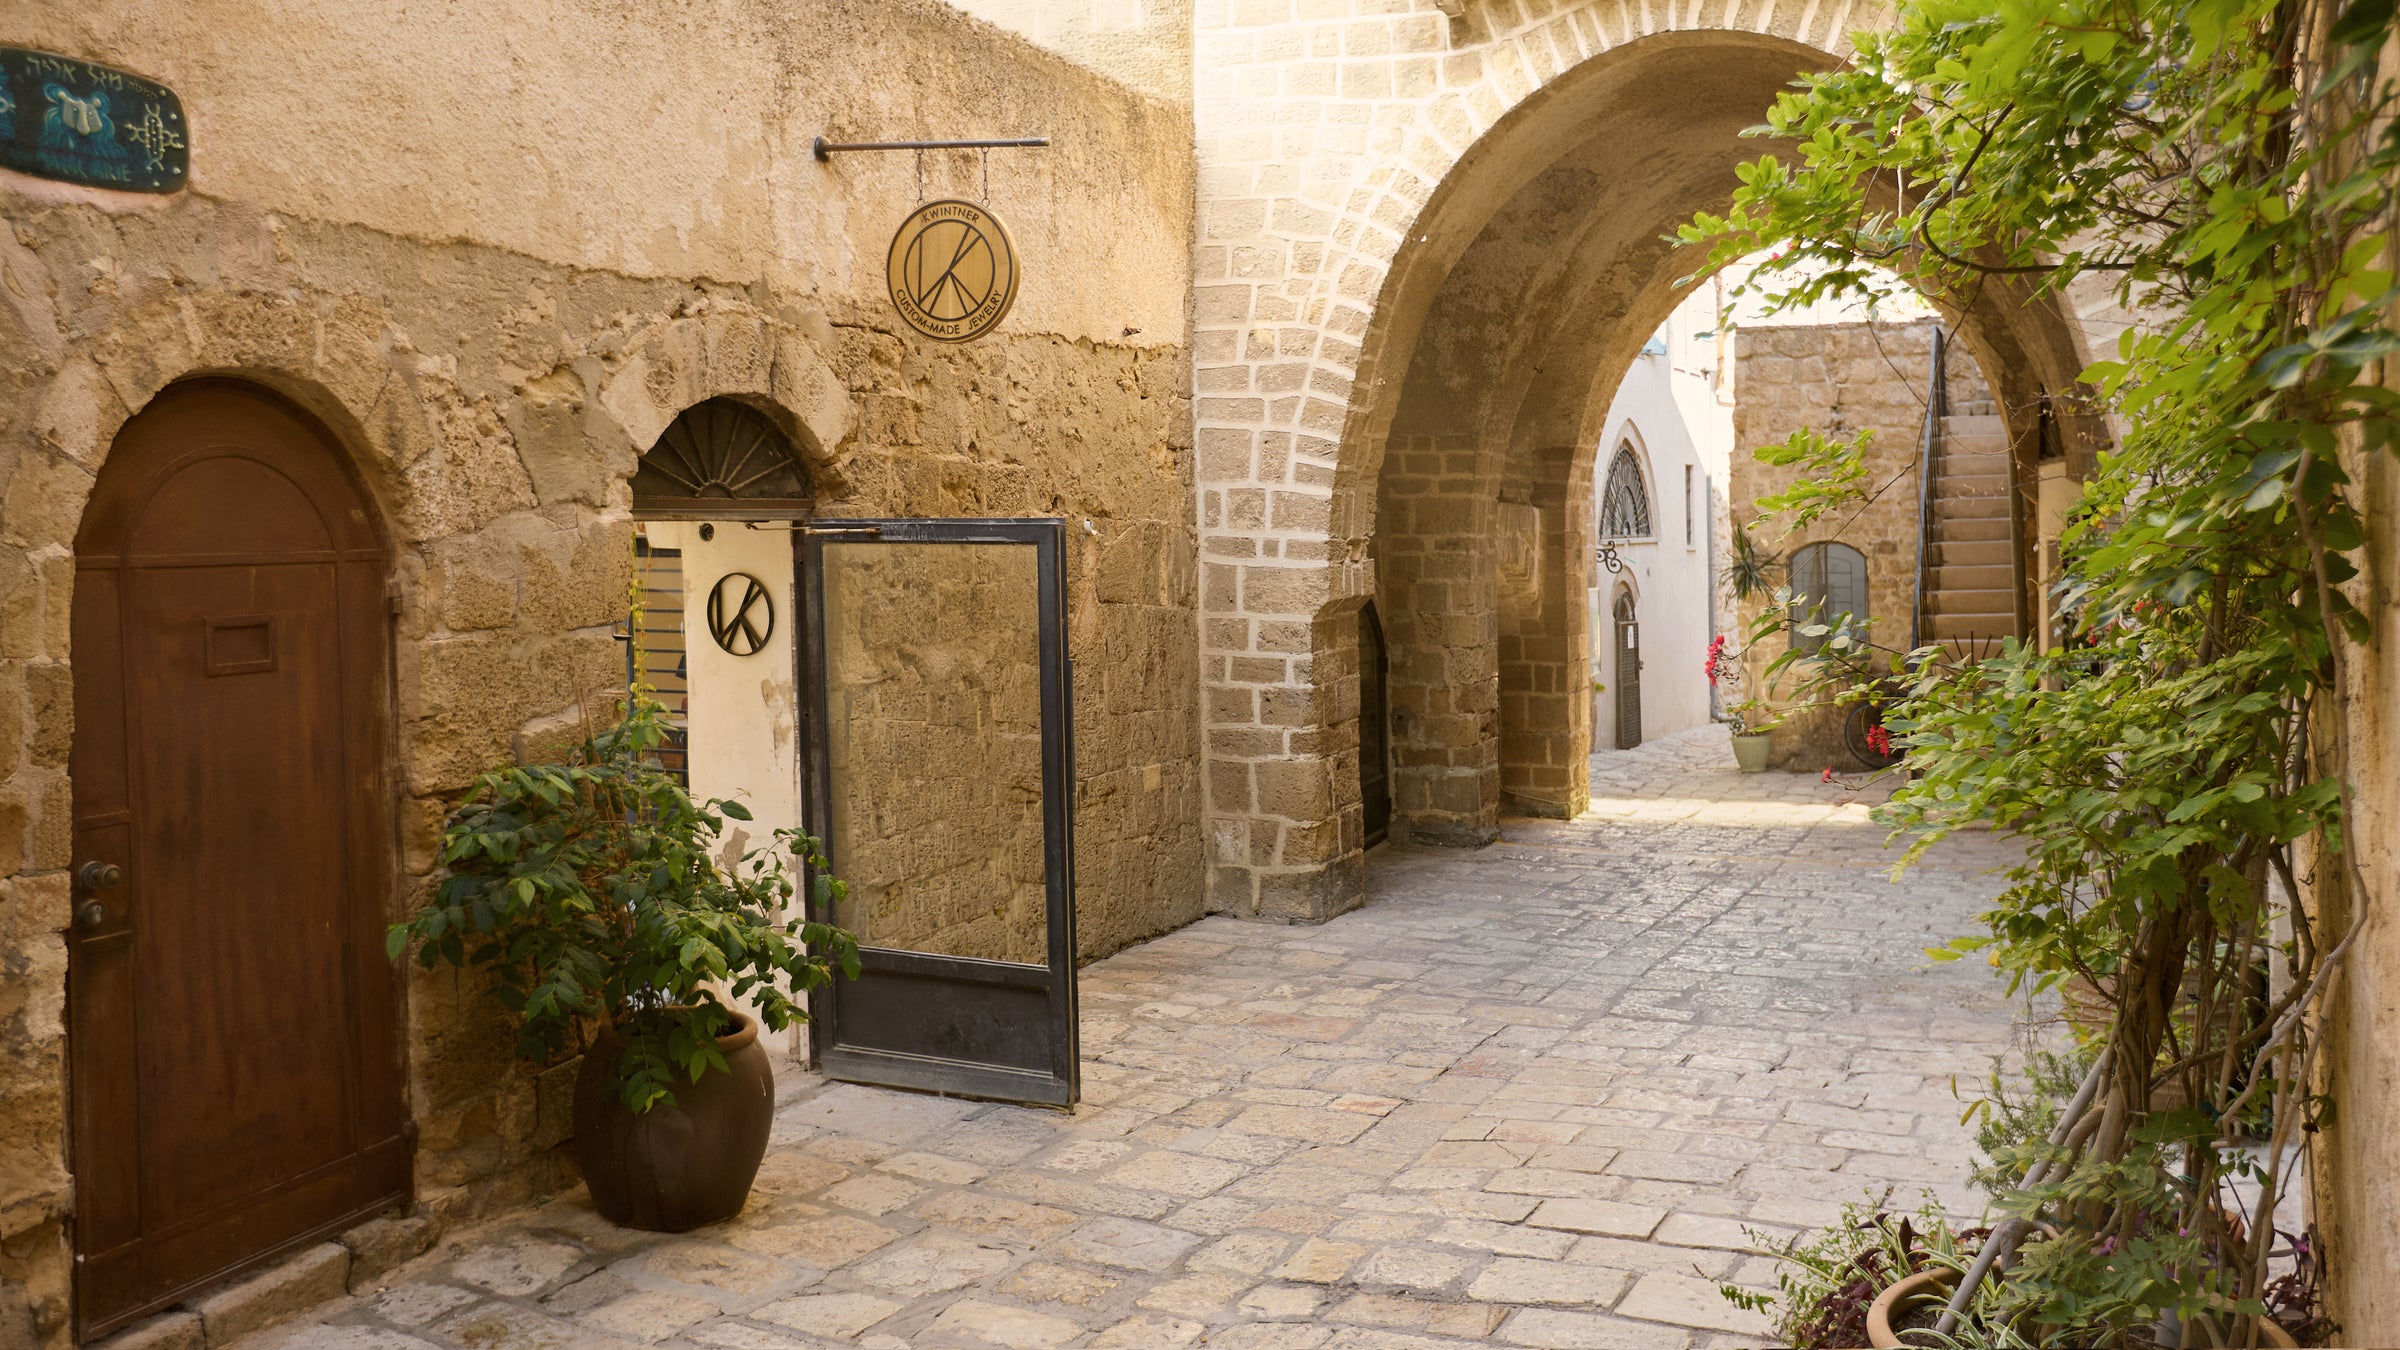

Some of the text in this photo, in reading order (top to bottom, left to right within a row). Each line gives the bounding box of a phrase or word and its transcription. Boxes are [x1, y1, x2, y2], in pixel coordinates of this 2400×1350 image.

[26, 56, 78, 84] אריה
[921, 206, 980, 223] KWINTNER
[896, 288, 1002, 335] CUSTOM-MADE JEWELRY
